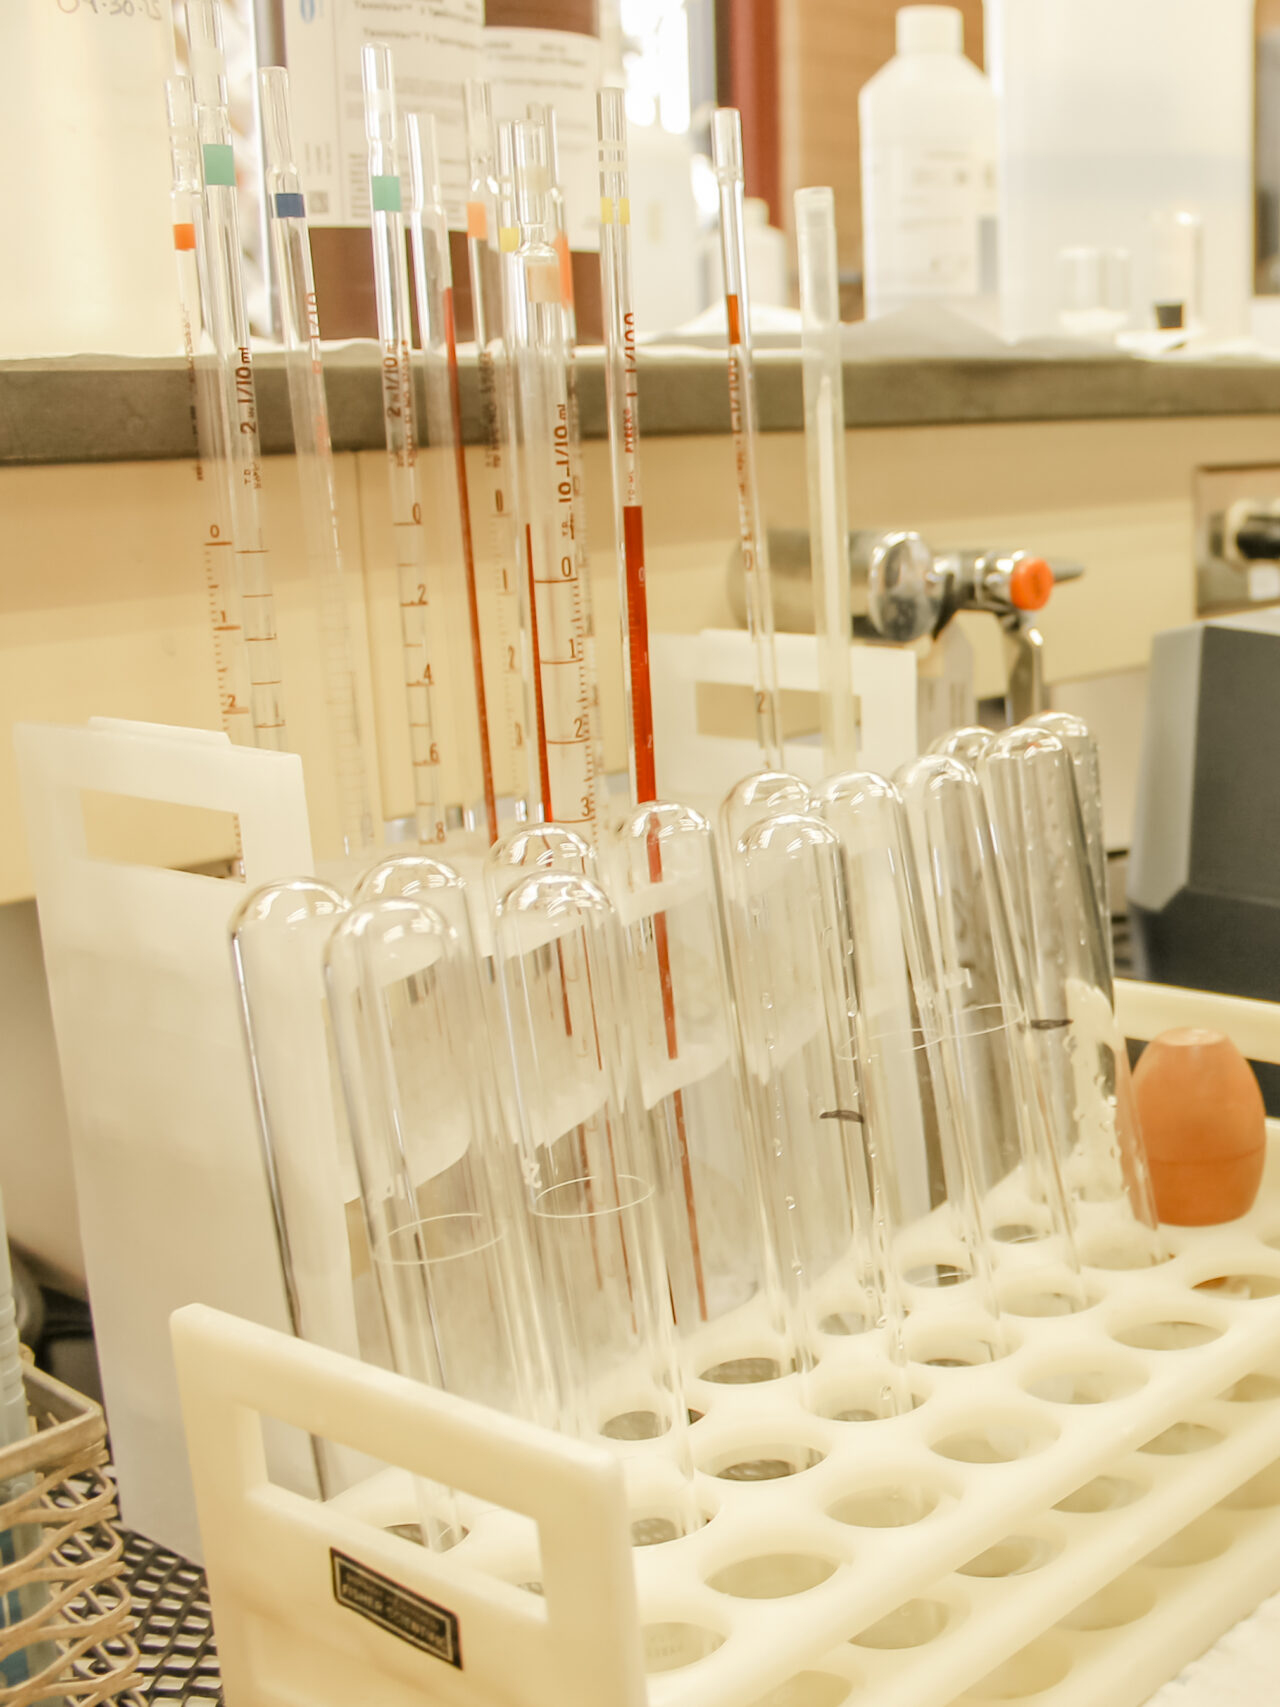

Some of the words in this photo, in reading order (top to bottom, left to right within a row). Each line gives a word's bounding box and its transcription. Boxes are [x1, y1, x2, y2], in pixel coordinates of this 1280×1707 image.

[384, 357, 400, 391] 1/10
[236, 366, 254, 404] 1/10
[387, 406, 402, 418] 2
[240, 421, 257, 435] 2
[554, 425, 569, 465] 1/10
[558, 482, 572, 503] 10
[412, 503, 422, 524] 0
[209, 524, 220, 538] 0
[561, 556, 572, 577] 0
[417, 584, 428, 603] 2
[220, 610, 227, 623] 1
[568, 638, 576, 659] 1
[423, 663, 433, 684] 4
[574, 718, 583, 738] 2
[429, 743, 439, 763] 6
[581, 796, 590, 817] 3
[435, 822, 445, 843] 8
